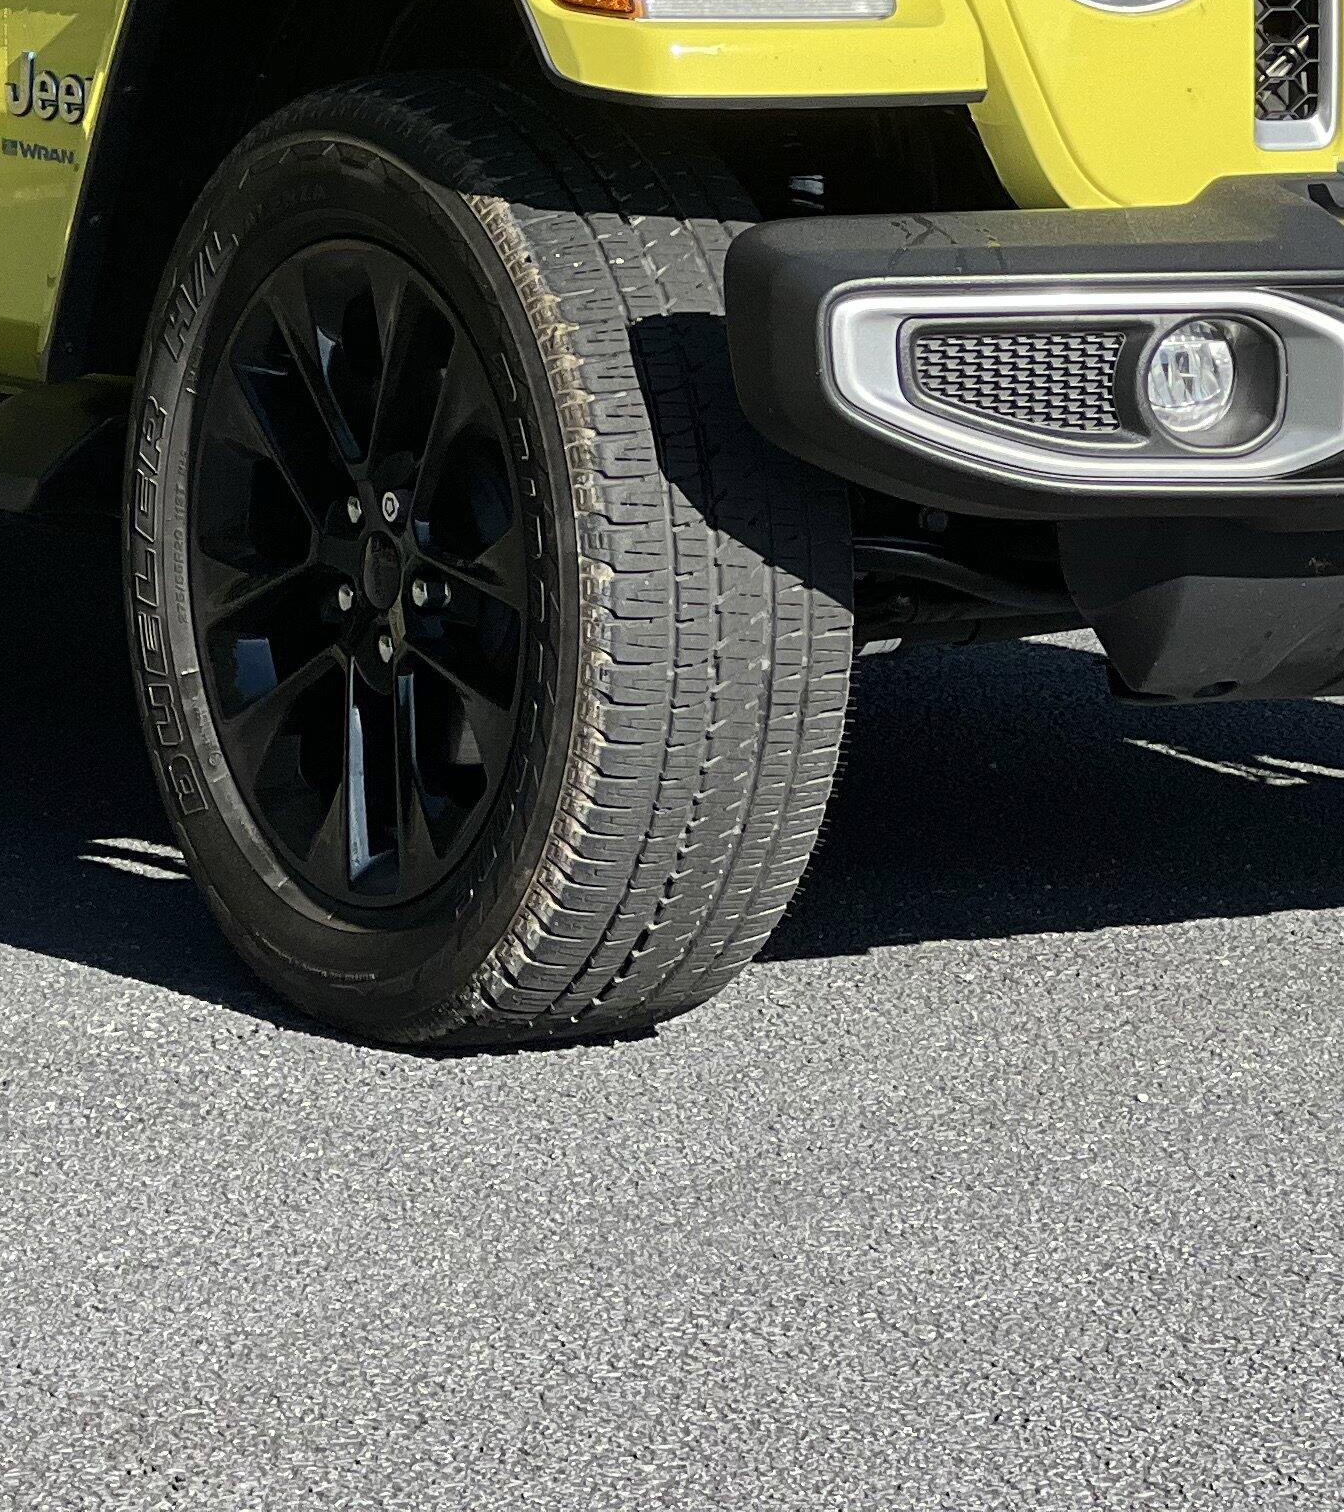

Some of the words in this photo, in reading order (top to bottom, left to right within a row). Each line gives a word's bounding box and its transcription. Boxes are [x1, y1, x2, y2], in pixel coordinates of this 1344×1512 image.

[6, 50, 93, 125] Jee
[19, 141, 80, 172] WRAN
[131, 396, 210, 818] DUELER
